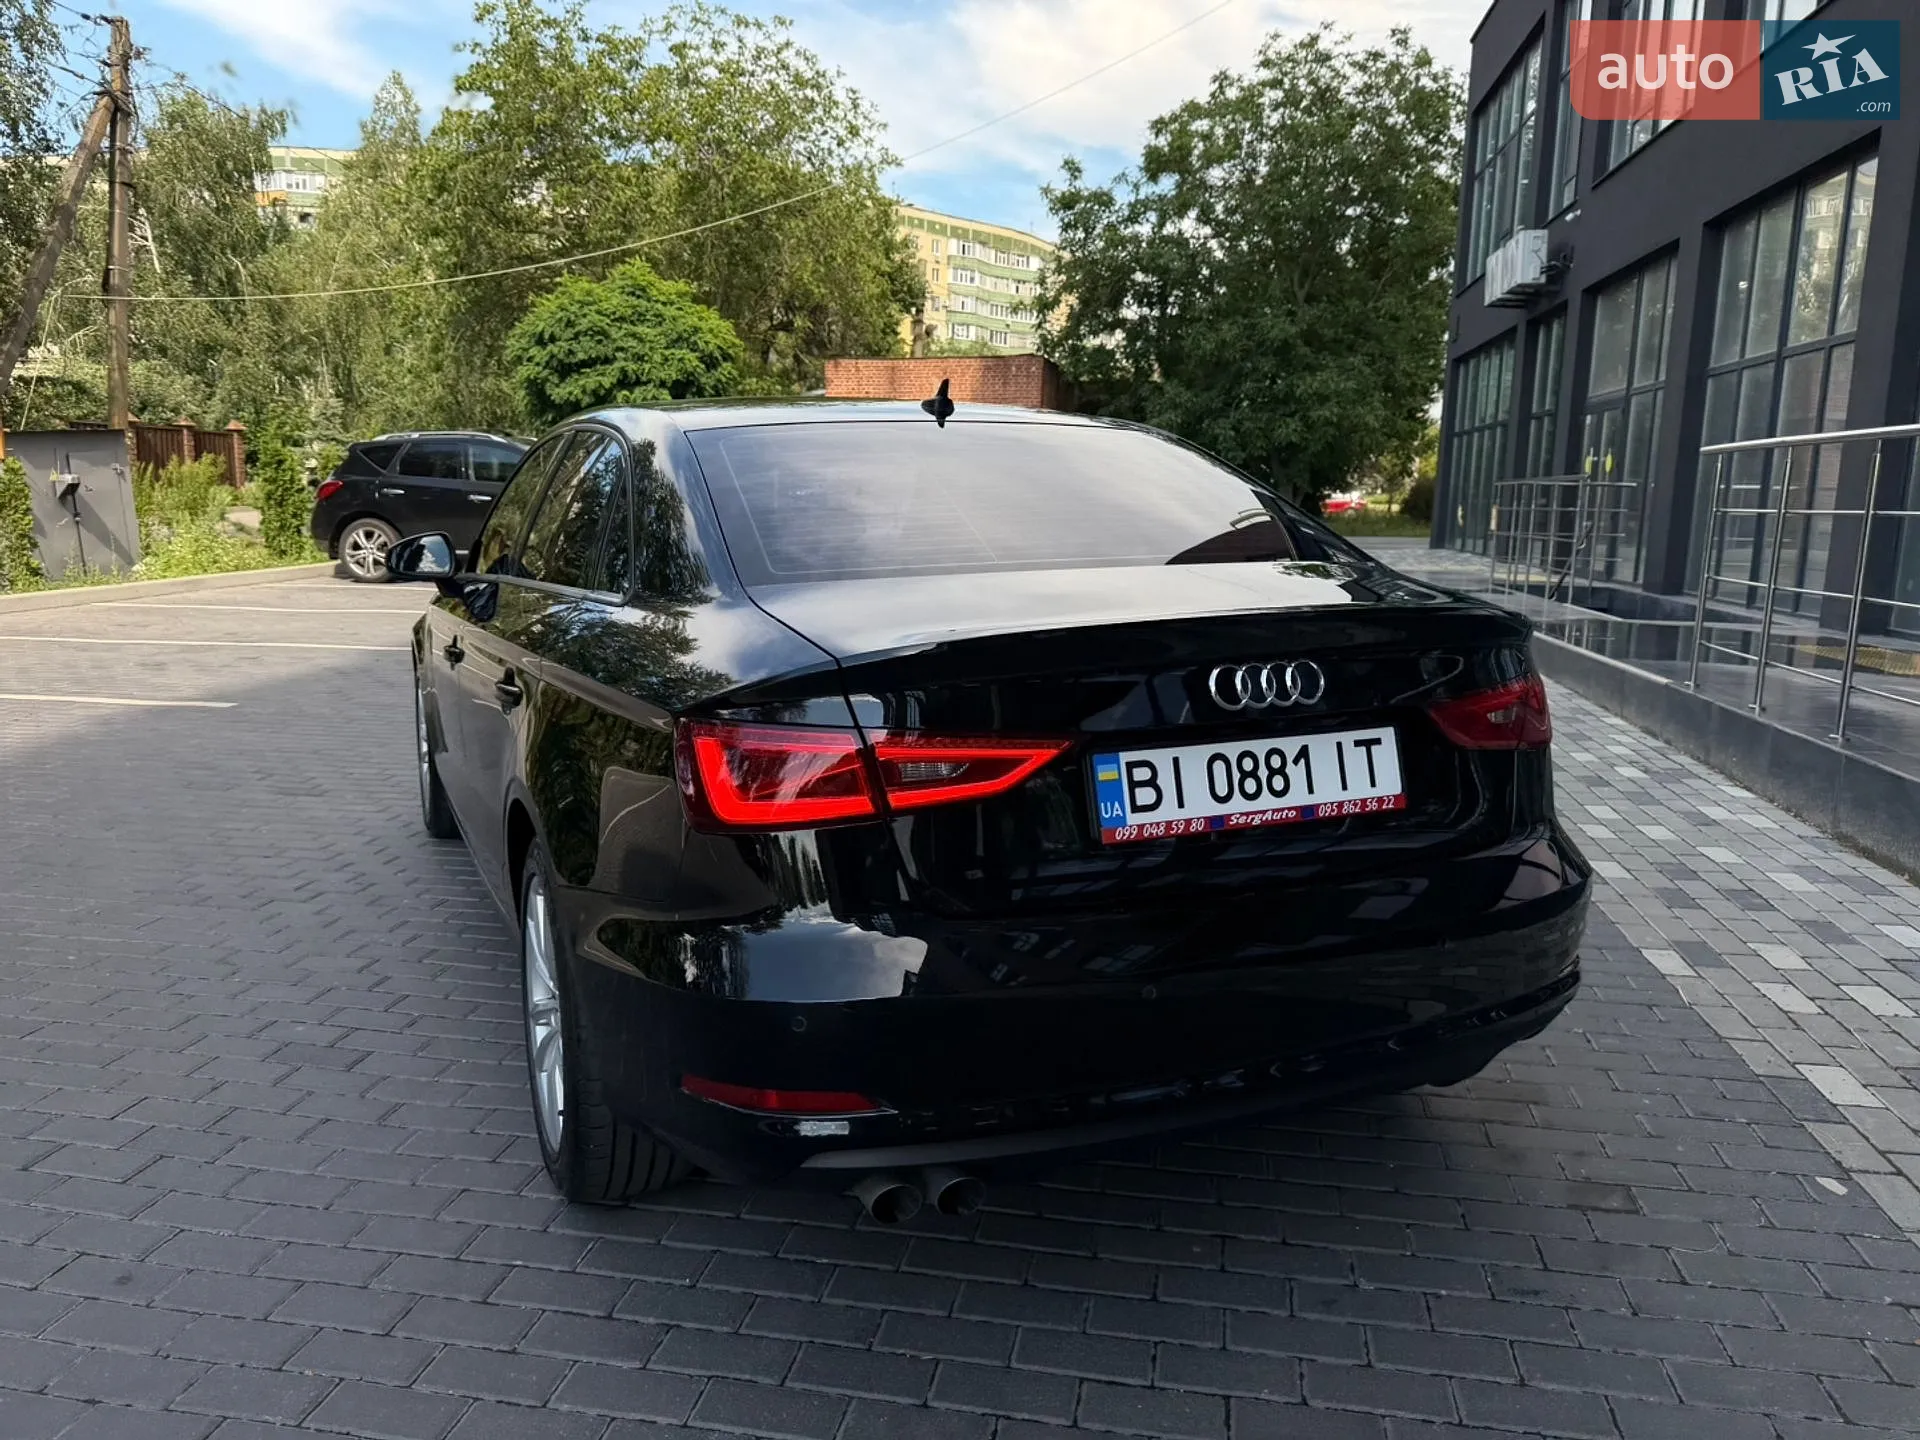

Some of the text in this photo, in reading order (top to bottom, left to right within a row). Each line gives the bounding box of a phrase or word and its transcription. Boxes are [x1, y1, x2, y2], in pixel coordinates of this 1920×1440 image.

[1125, 737, 1382, 814] BI 0881 IT
[1101, 801, 1123, 819] UA
[1115, 796, 1395, 840] 099 048 59 80 SergAuto 095 862 56 22
